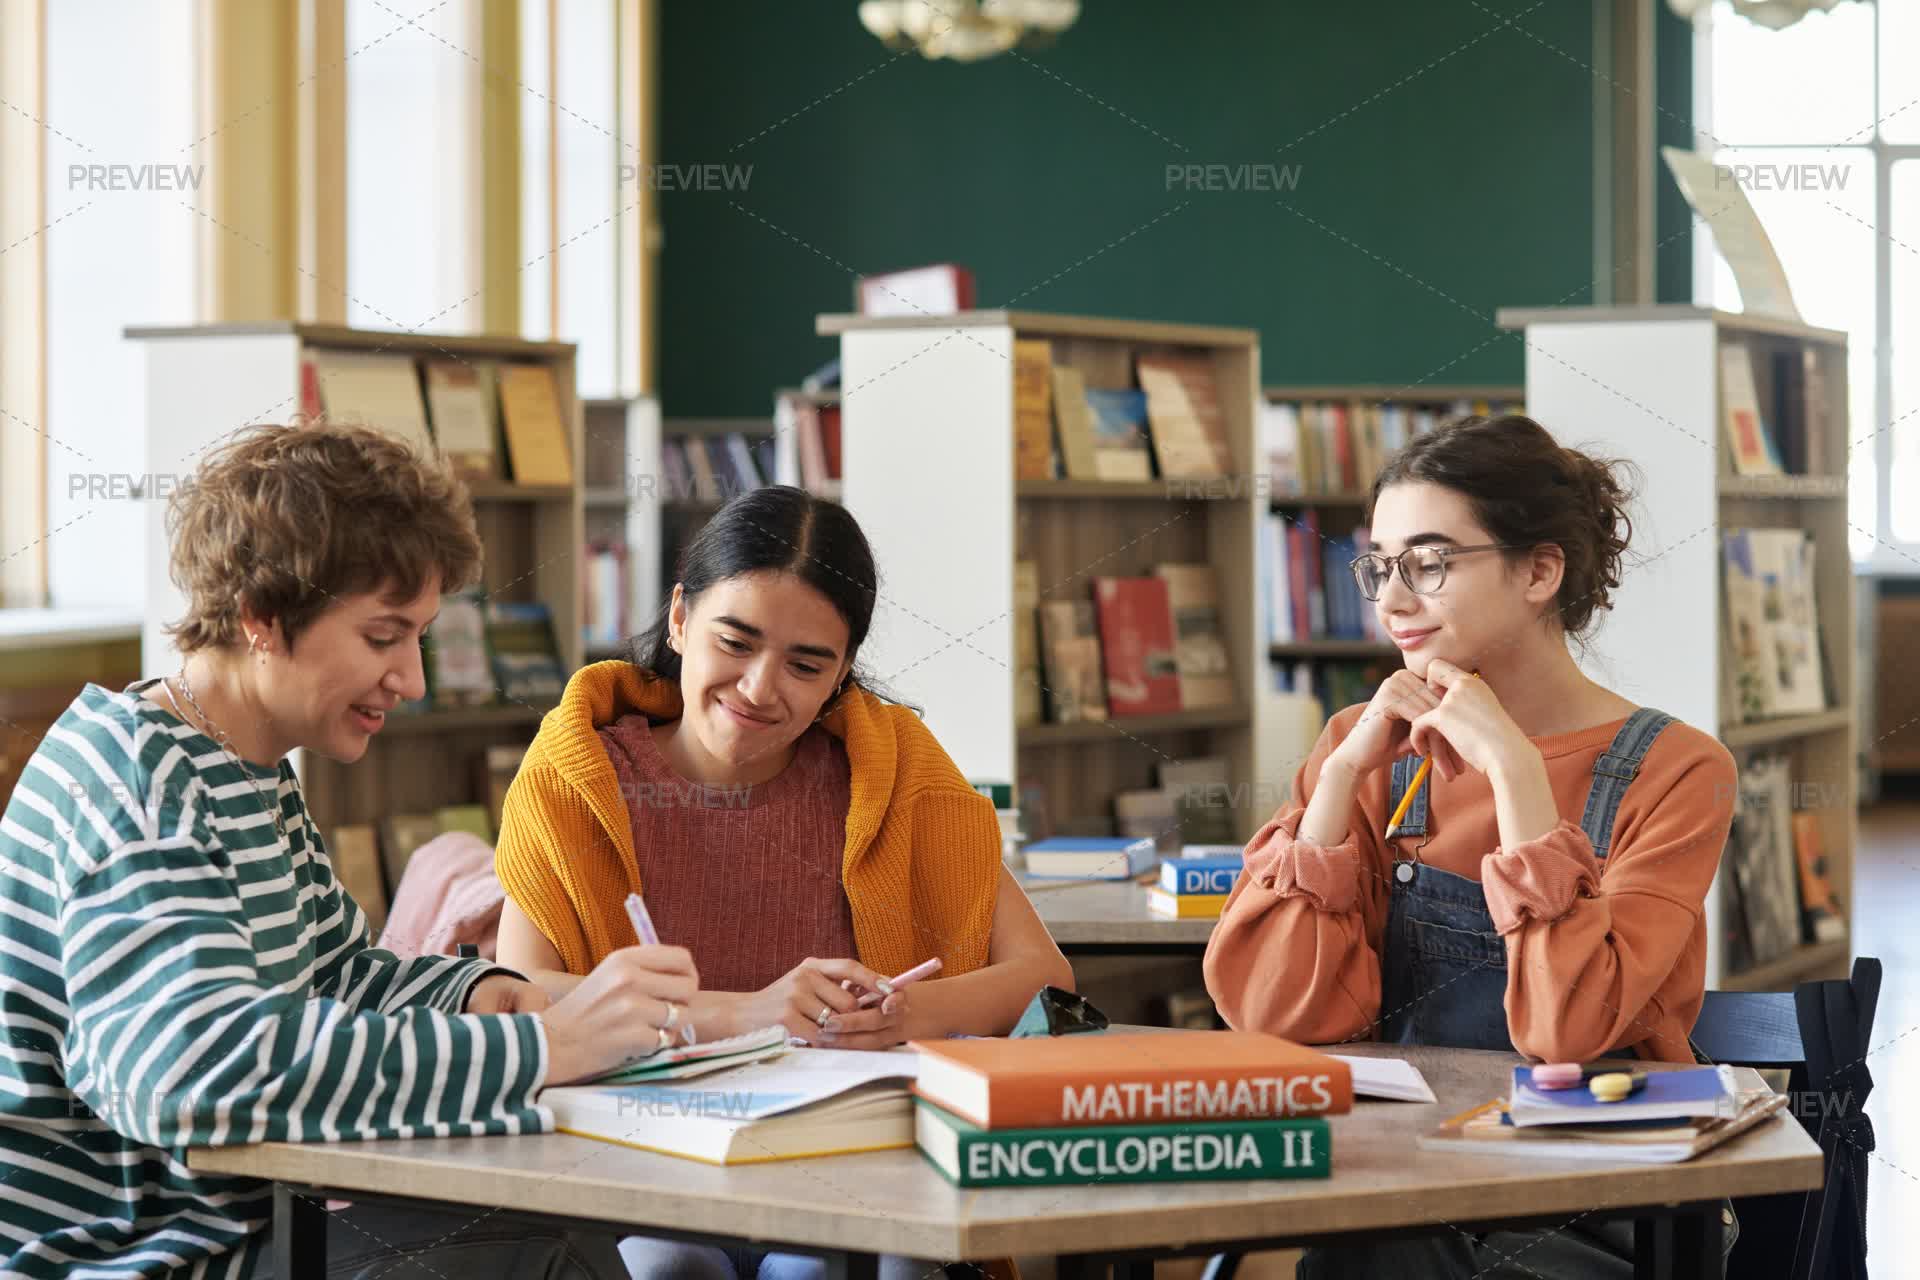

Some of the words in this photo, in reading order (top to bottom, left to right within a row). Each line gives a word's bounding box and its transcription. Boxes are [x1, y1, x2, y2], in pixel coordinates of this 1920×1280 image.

[1062, 1075, 1331, 1121] MATHEMATICS
[967, 1133, 1262, 1180] ENCYCLOPEDIA
[1282, 1130, 1315, 1167] II
